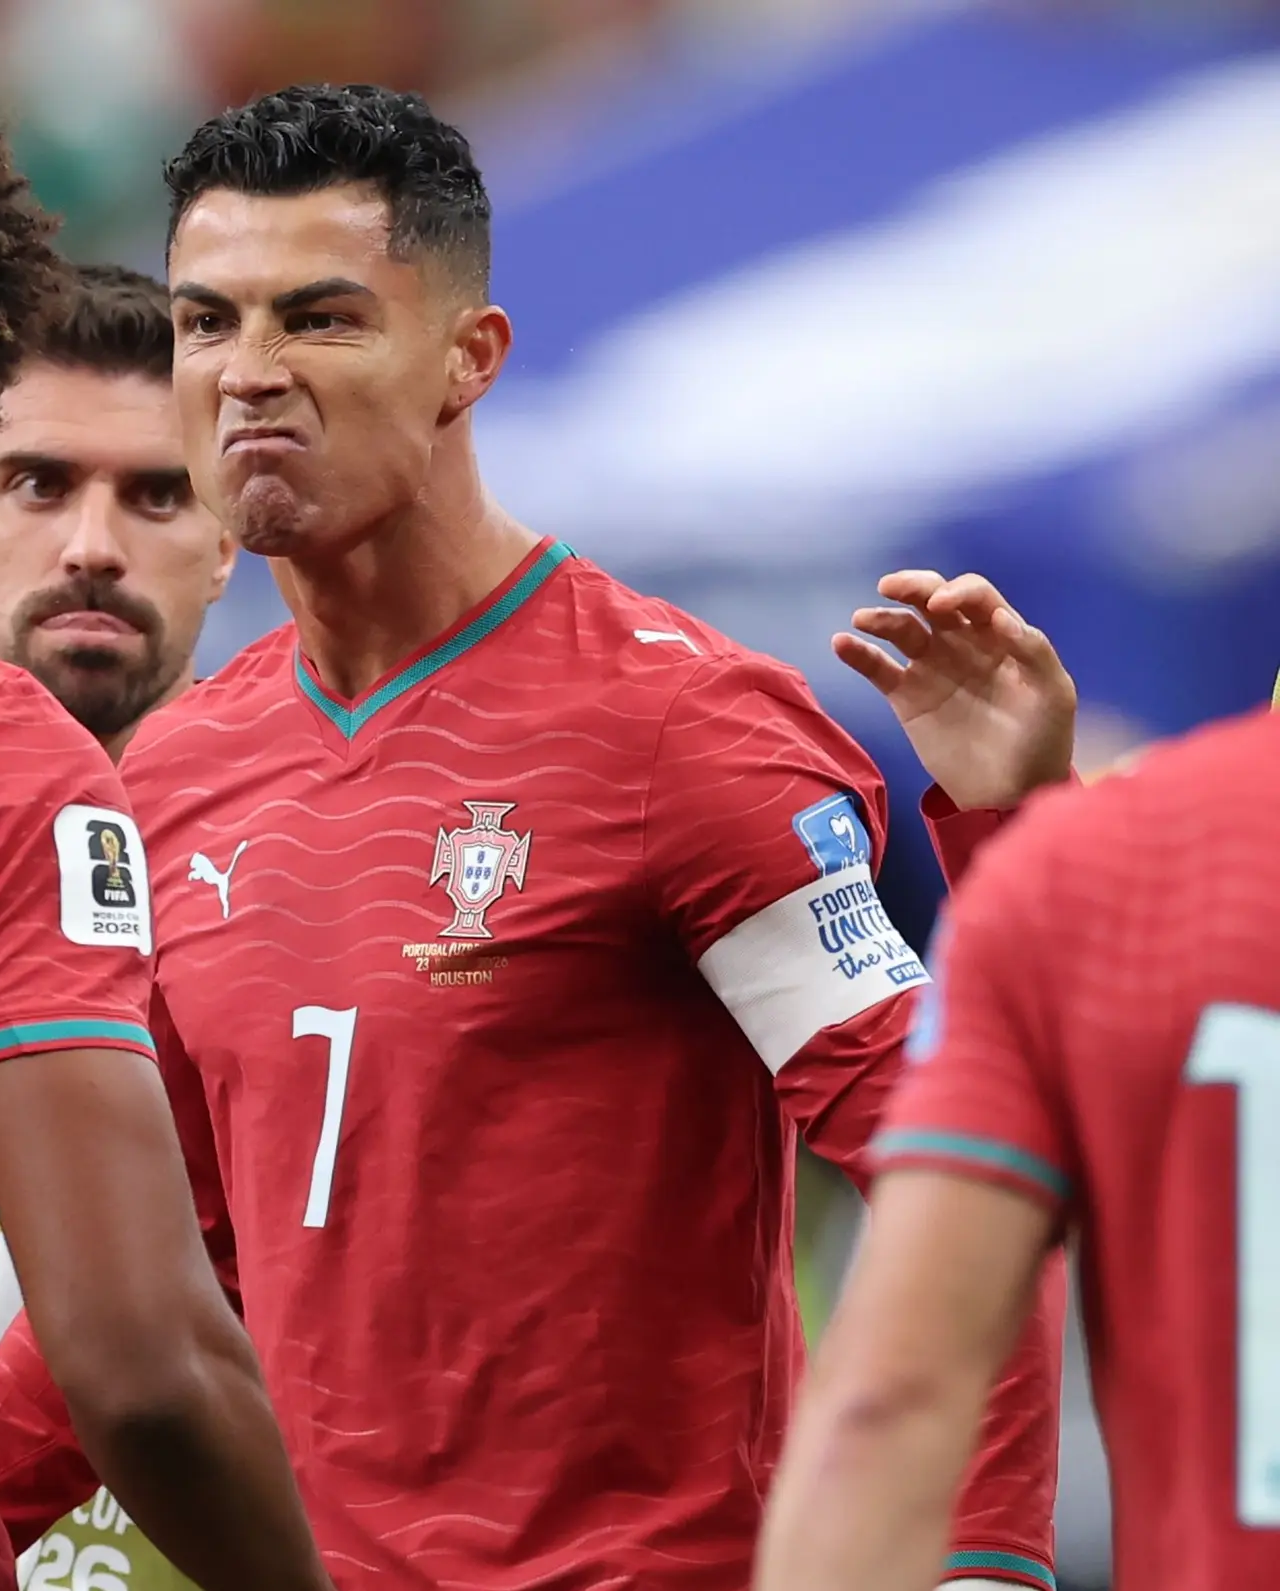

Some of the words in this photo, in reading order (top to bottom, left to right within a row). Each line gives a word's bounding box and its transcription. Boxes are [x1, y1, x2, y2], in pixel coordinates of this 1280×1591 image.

[104, 889, 129, 902] FIFA
[818, 905, 892, 954] UNITE
[416, 957, 429, 971] 23
[431, 969, 493, 987] HOUSTON
[832, 951, 881, 980] the
[291, 1005, 358, 1228] 7
[1180, 1002, 1280, 1528] 1
